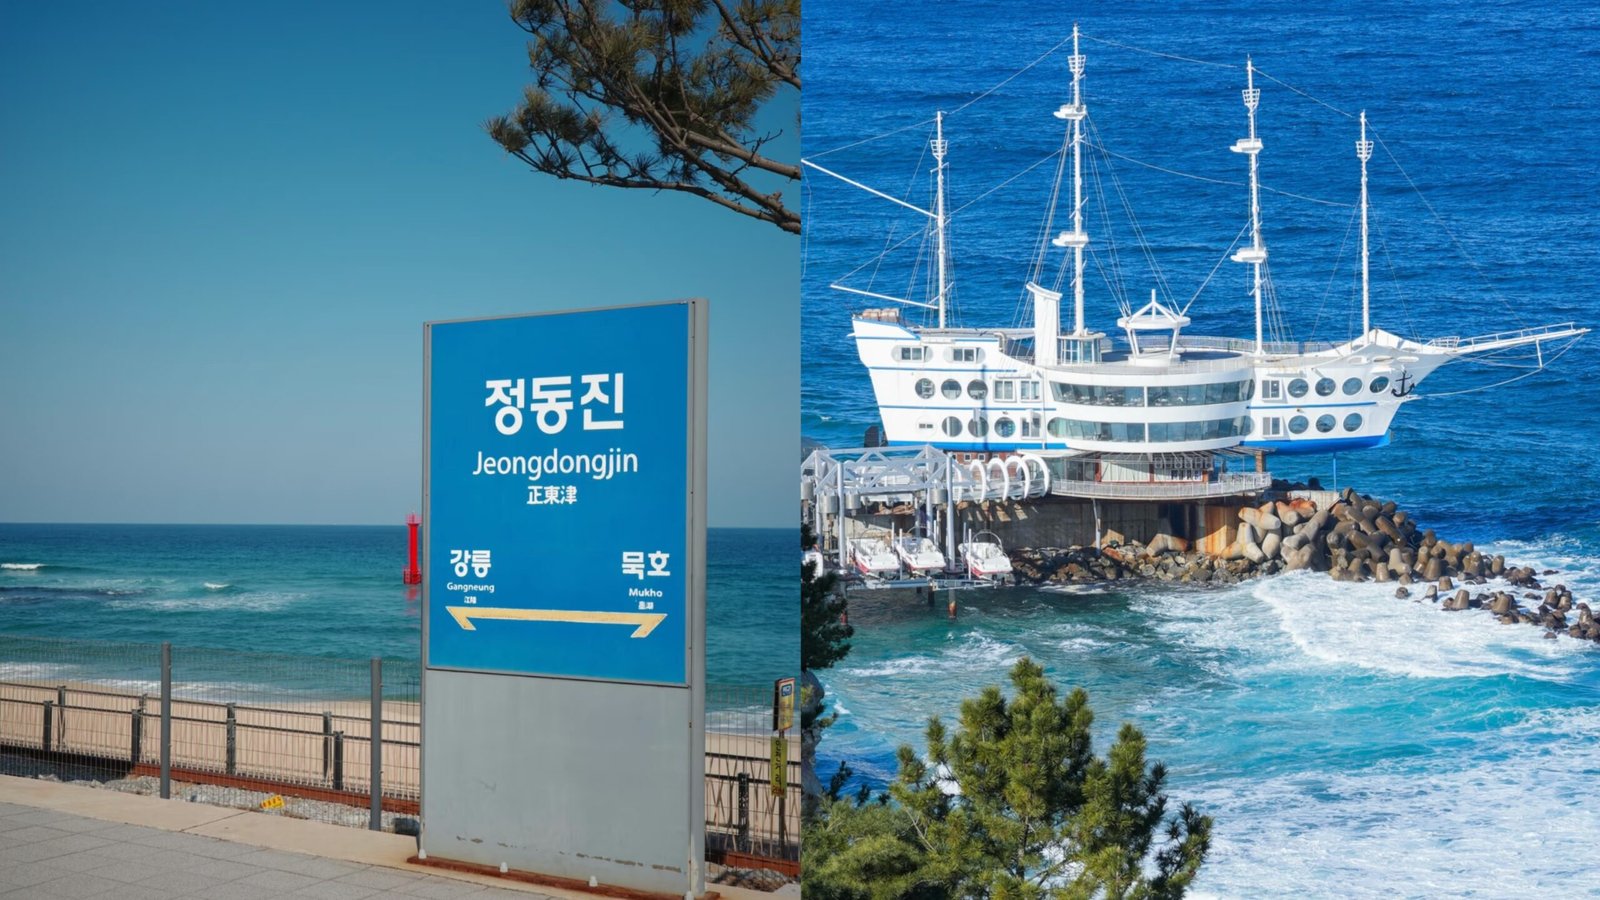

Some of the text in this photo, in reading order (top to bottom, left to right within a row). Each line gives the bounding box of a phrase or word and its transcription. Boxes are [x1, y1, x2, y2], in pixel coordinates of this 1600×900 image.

[485, 372, 624, 435] 정동진
[473, 448, 638, 480] Jeongdongjin
[526, 485, 577, 505] 正東津
[450, 549, 492, 578] 강릉
[621, 550, 671, 580] 묵호
[446, 582, 495, 594] Gangneung
[628, 587, 663, 598] Mukho
